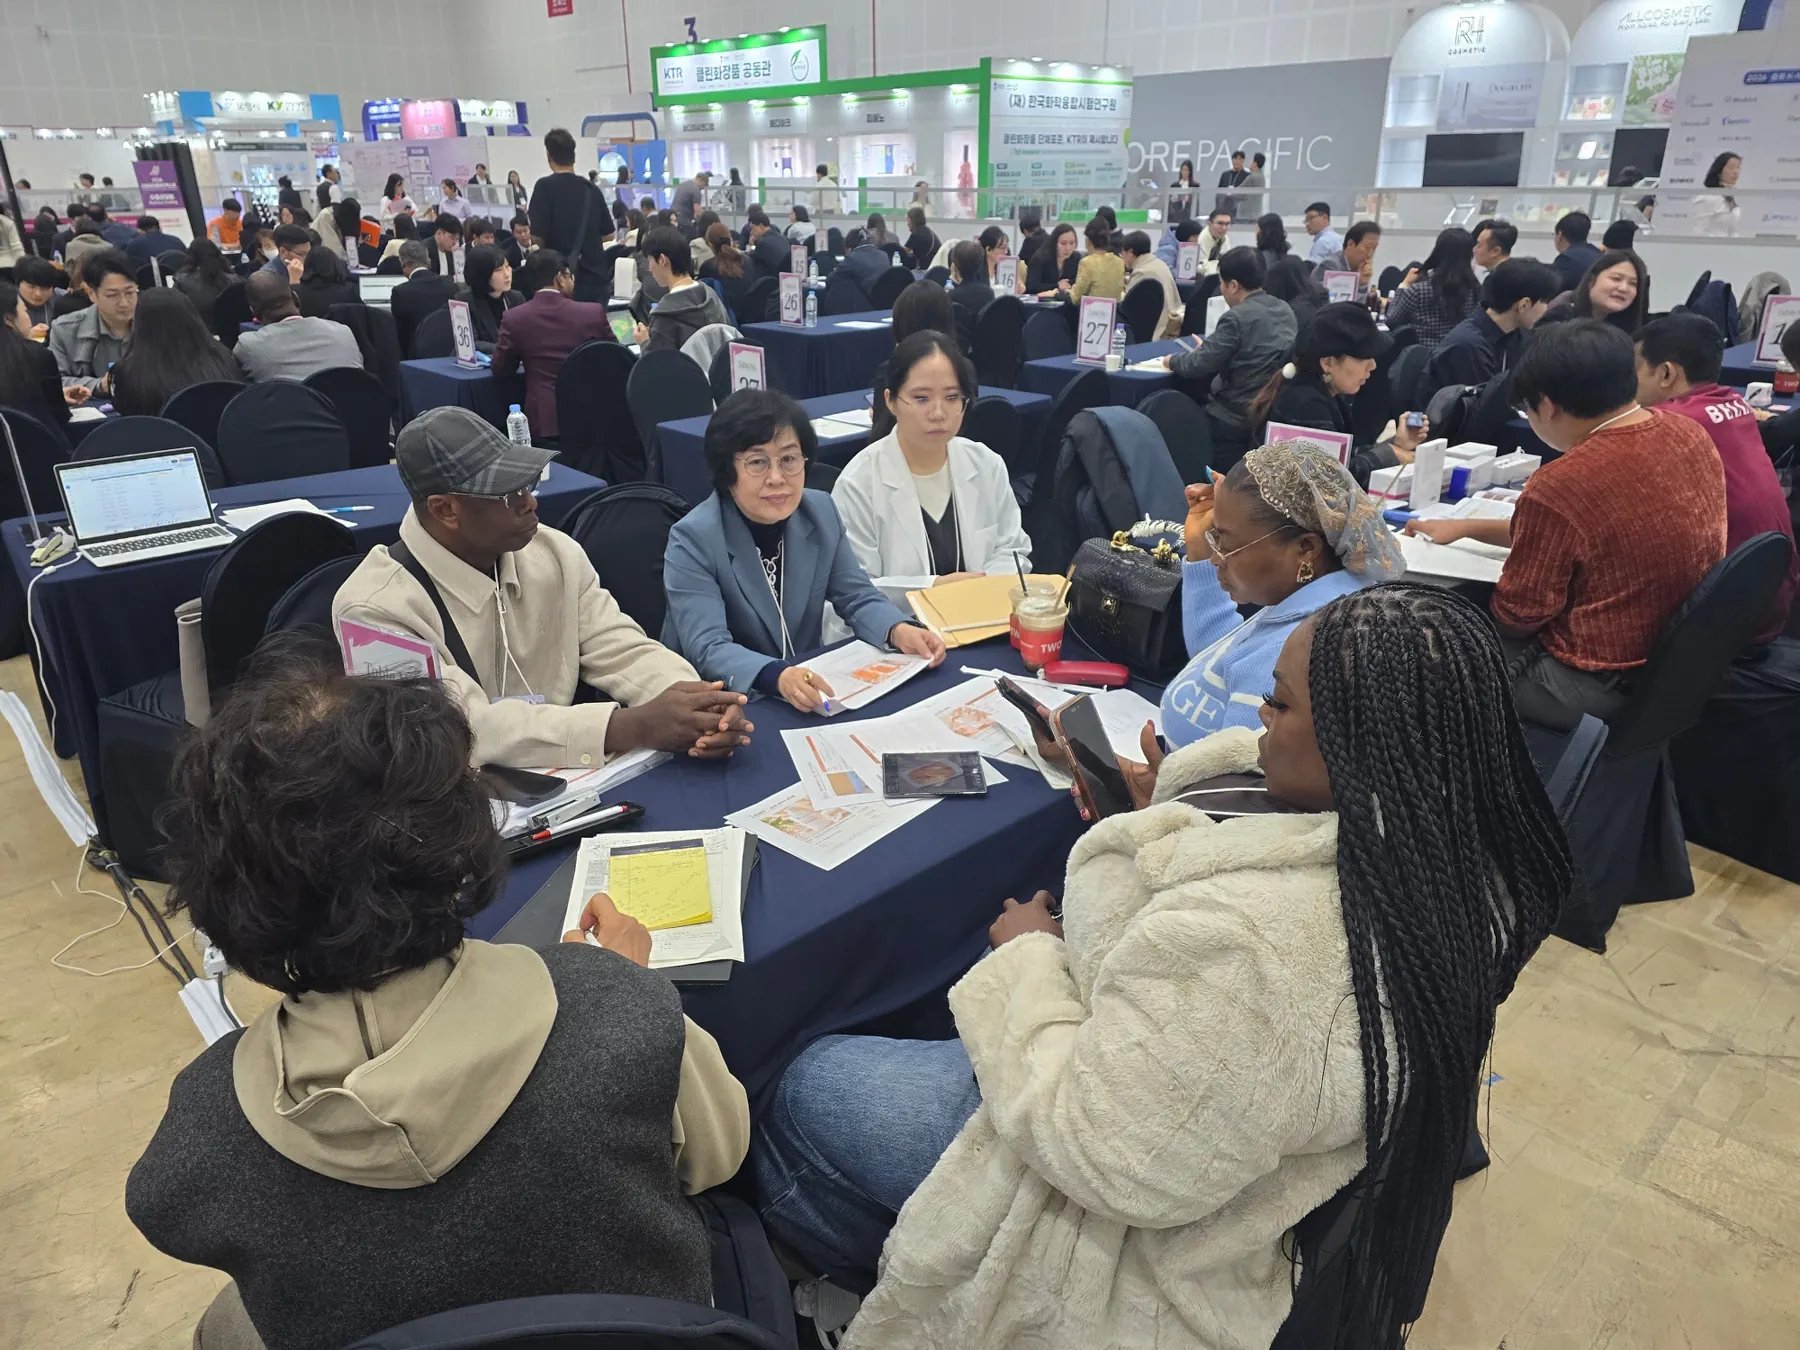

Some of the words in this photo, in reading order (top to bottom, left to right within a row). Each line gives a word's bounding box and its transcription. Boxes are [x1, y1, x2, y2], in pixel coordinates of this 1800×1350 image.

[663, 67, 683, 79] KTR
[743, 60, 771, 78] 공동관
[1184, 257, 1192, 271] 6
[1001, 273, 1014, 288] 16
[784, 292, 798, 311] 26
[456, 325, 470, 348] 36
[1084, 321, 1109, 345] 27
[1769, 322, 1787, 345] 1
[1040, 640, 1063, 654] TWO
